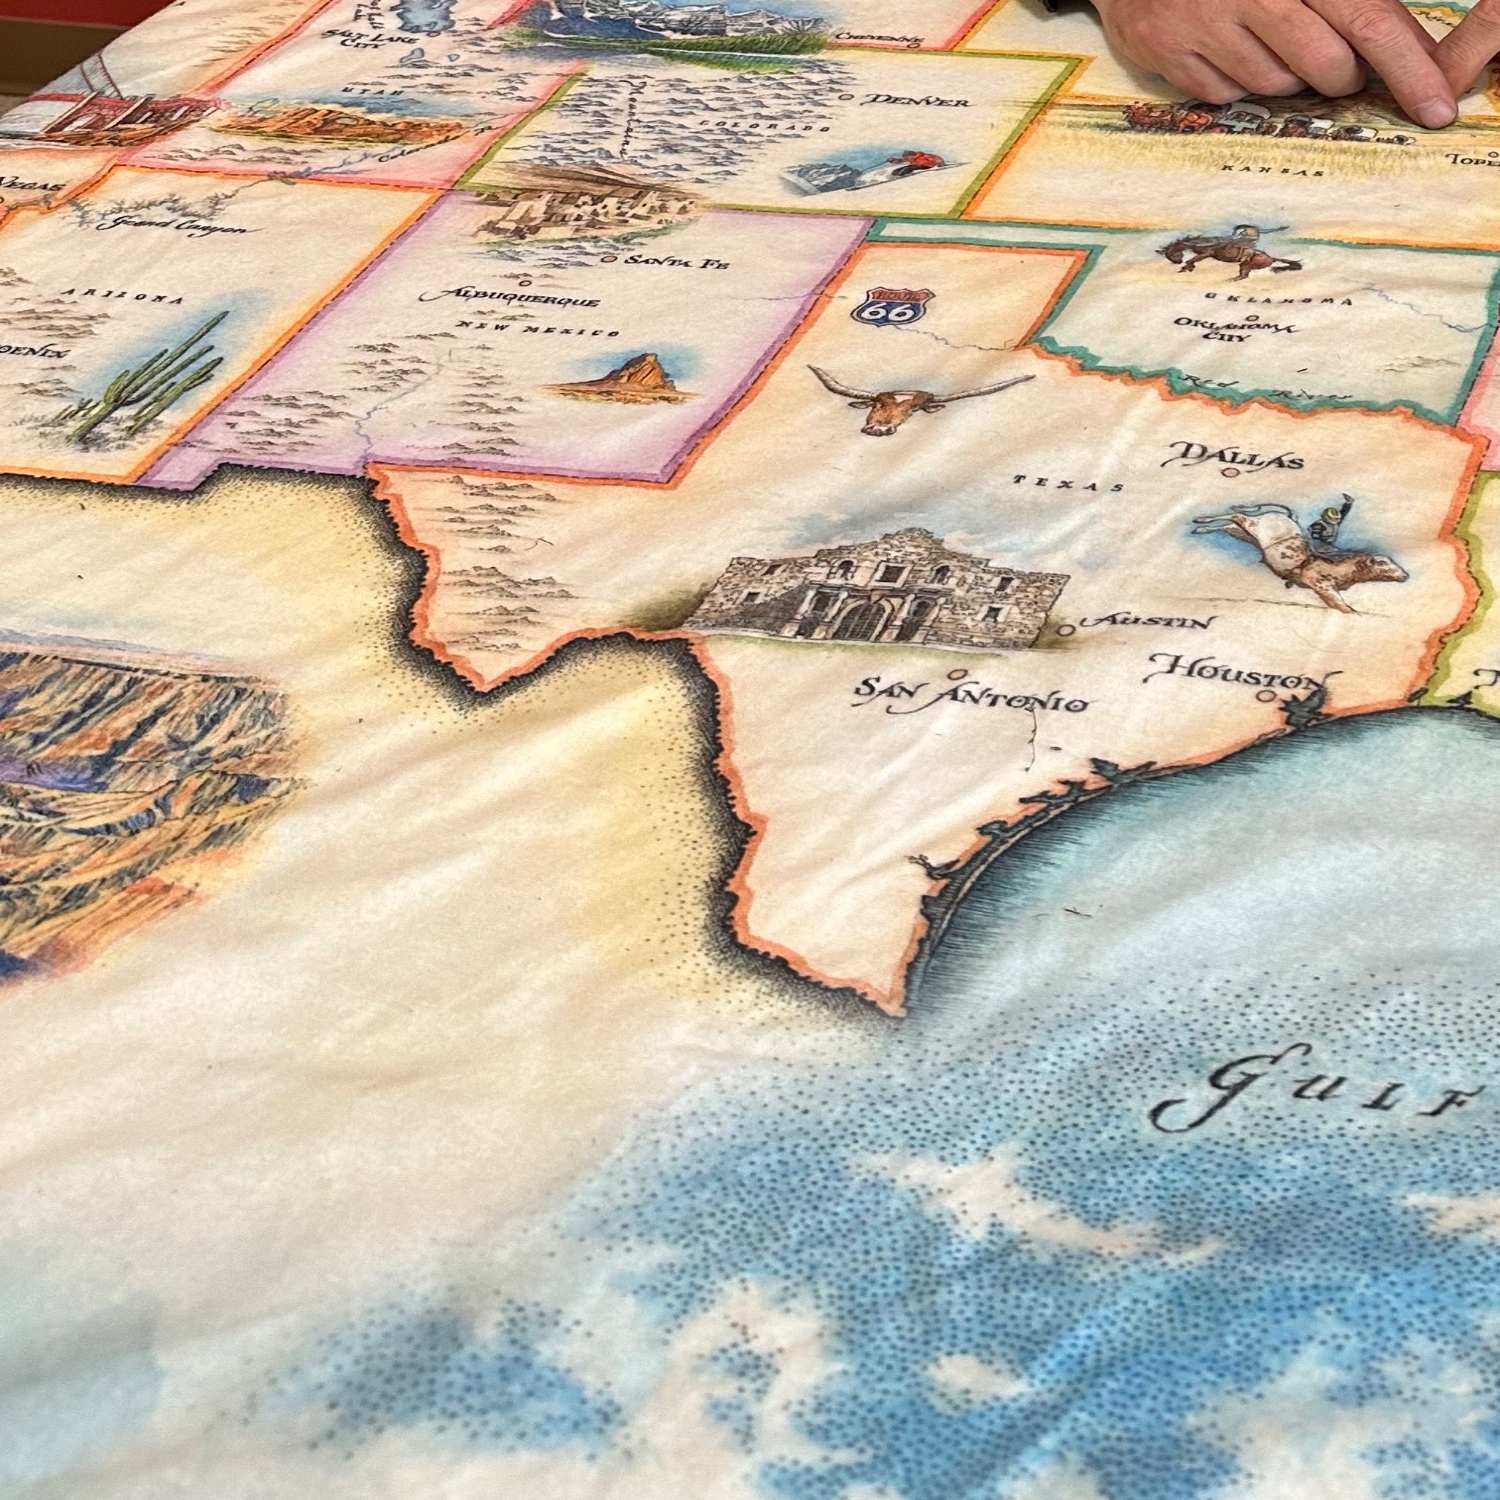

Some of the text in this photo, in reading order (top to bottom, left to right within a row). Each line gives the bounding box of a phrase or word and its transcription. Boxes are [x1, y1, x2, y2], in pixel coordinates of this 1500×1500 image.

[1415, 10, 1456, 28] Rive
[321, 28, 420, 45] SALT LAKE
[834, 30, 926, 46] CHEYENNE
[341, 86, 405, 96] UTAH
[863, 90, 971, 109] DENVER
[699, 119, 831, 133] COLORADO
[1221, 163, 1327, 179] KANSAS
[175, 218, 262, 239] Canyon
[623, 250, 732, 271] SANTA FE
[60, 286, 185, 306] ARIZONA
[418, 284, 602, 311] ALBUQUERQUE
[1203, 291, 1355, 307] OKLAHOMA
[861, 301, 915, 322] 66
[455, 318, 620, 338] NEW MEXICO
[1172, 315, 1304, 334] OKLAHOMA
[1201, 328, 1253, 344] CITY
[0, 342, 72, 360] OENIX
[1159, 440, 1306, 474] DALLAS
[1012, 473, 1126, 493] TEXAS
[1079, 610, 1218, 632] AUSTIN
[1141, 652, 1345, 693] HOUSTON
[850, 675, 1097, 716] SAN ANTONIO
